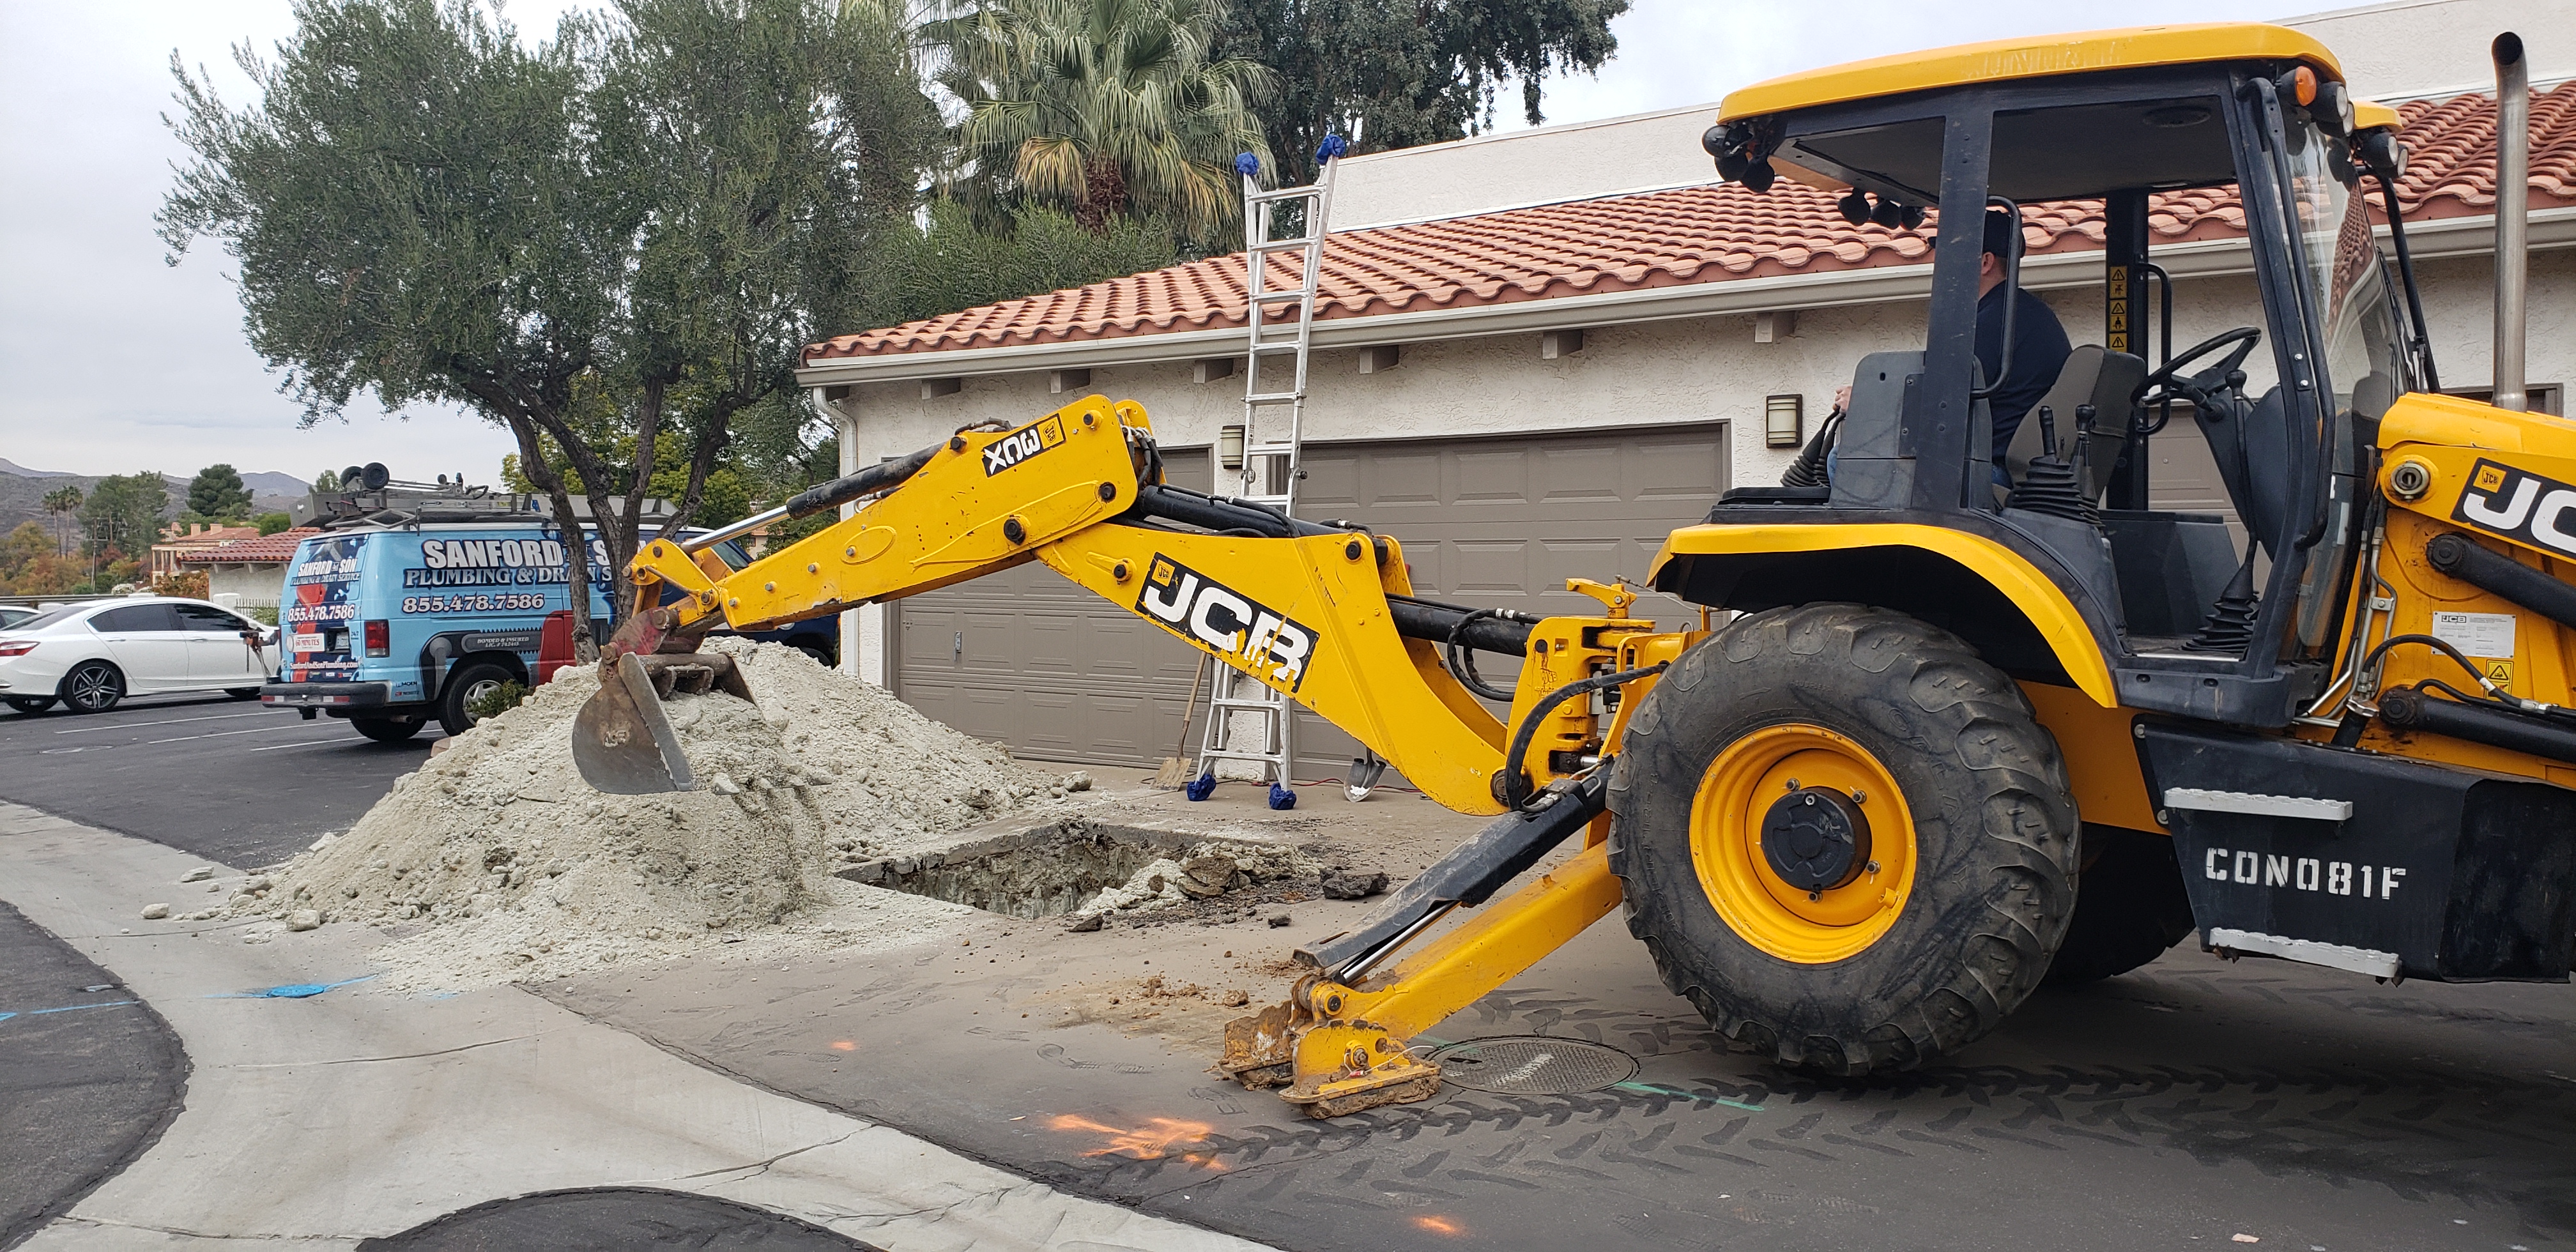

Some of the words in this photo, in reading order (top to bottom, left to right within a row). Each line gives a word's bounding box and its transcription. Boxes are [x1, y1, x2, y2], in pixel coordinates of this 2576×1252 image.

[2483, 473, 2498, 484] JCB
[423, 540, 564, 568] SANFORD
[298, 560, 333, 577] SANFORD
[339, 558, 358, 573] SON
[406, 569, 511, 586] PLUMBING
[516, 567, 534, 583] &
[402, 593, 545, 613] 855.478.7586
[288, 604, 355, 623] 855.478.7586
[1144, 573, 1310, 682] JCB
[290, 660, 358, 671] SanfordAndSonPlumbing.com
